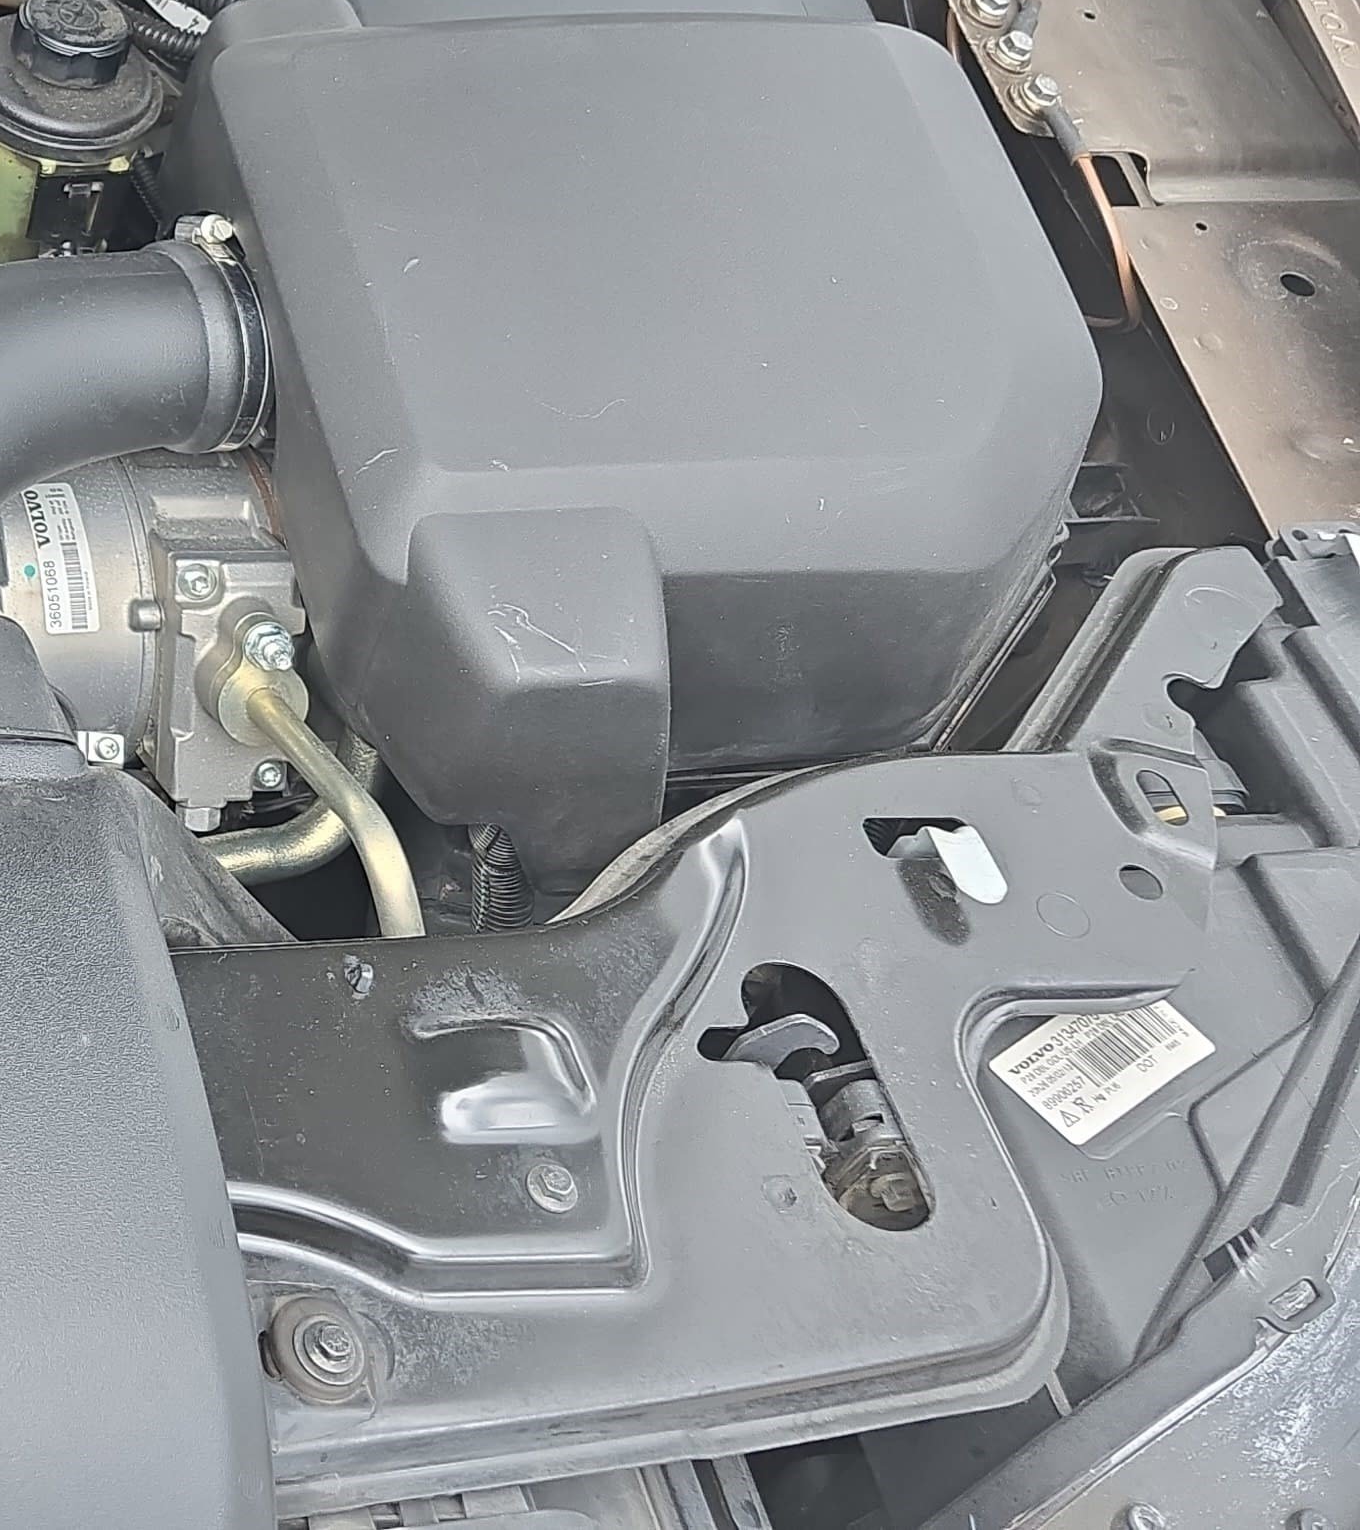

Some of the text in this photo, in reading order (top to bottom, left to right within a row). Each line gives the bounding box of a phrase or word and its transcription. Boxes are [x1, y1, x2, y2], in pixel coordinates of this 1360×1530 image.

[24, 489, 51, 549] VOLVO
[41, 559, 63, 629] 36051068
[1008, 1042, 1054, 1075] VOLVO
[1135, 1054, 1162, 1074] DOT
